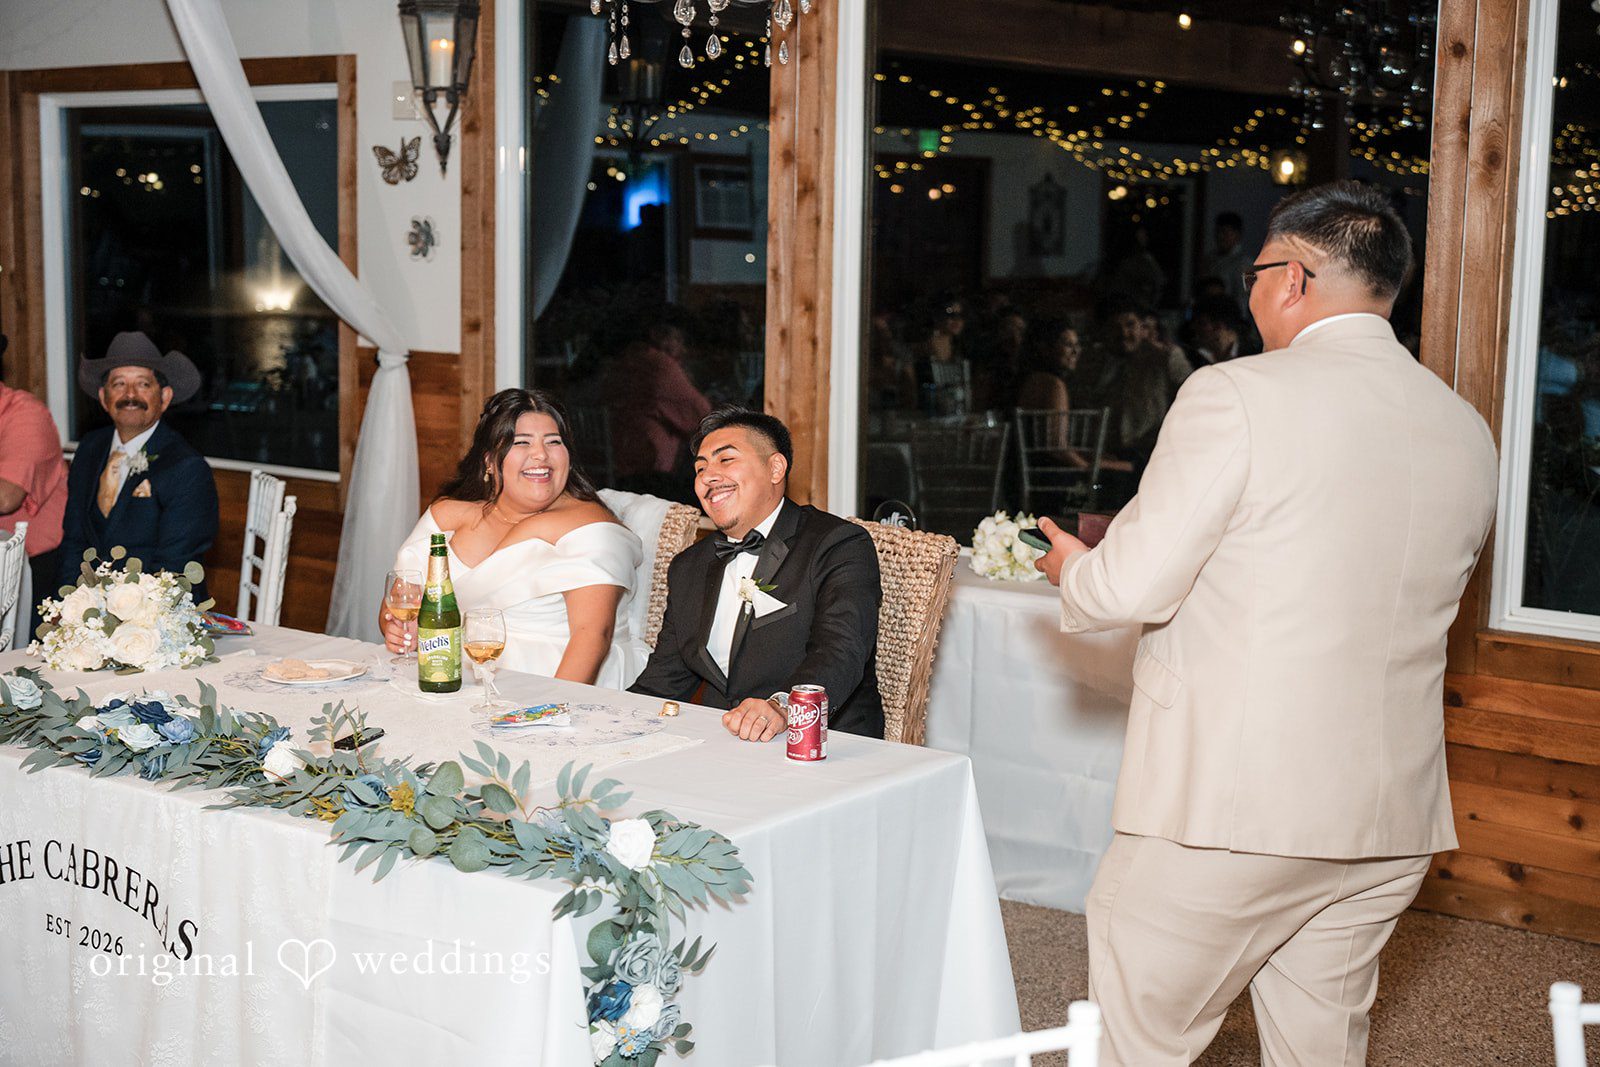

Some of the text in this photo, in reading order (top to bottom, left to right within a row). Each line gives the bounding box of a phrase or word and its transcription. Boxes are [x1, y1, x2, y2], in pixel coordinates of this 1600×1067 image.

[419, 636, 449, 652] Welch's
[793, 703, 807, 716] Dr
[0, 839, 199, 961] HE CABRERAS
[46, 913, 124, 956] EST 2026
